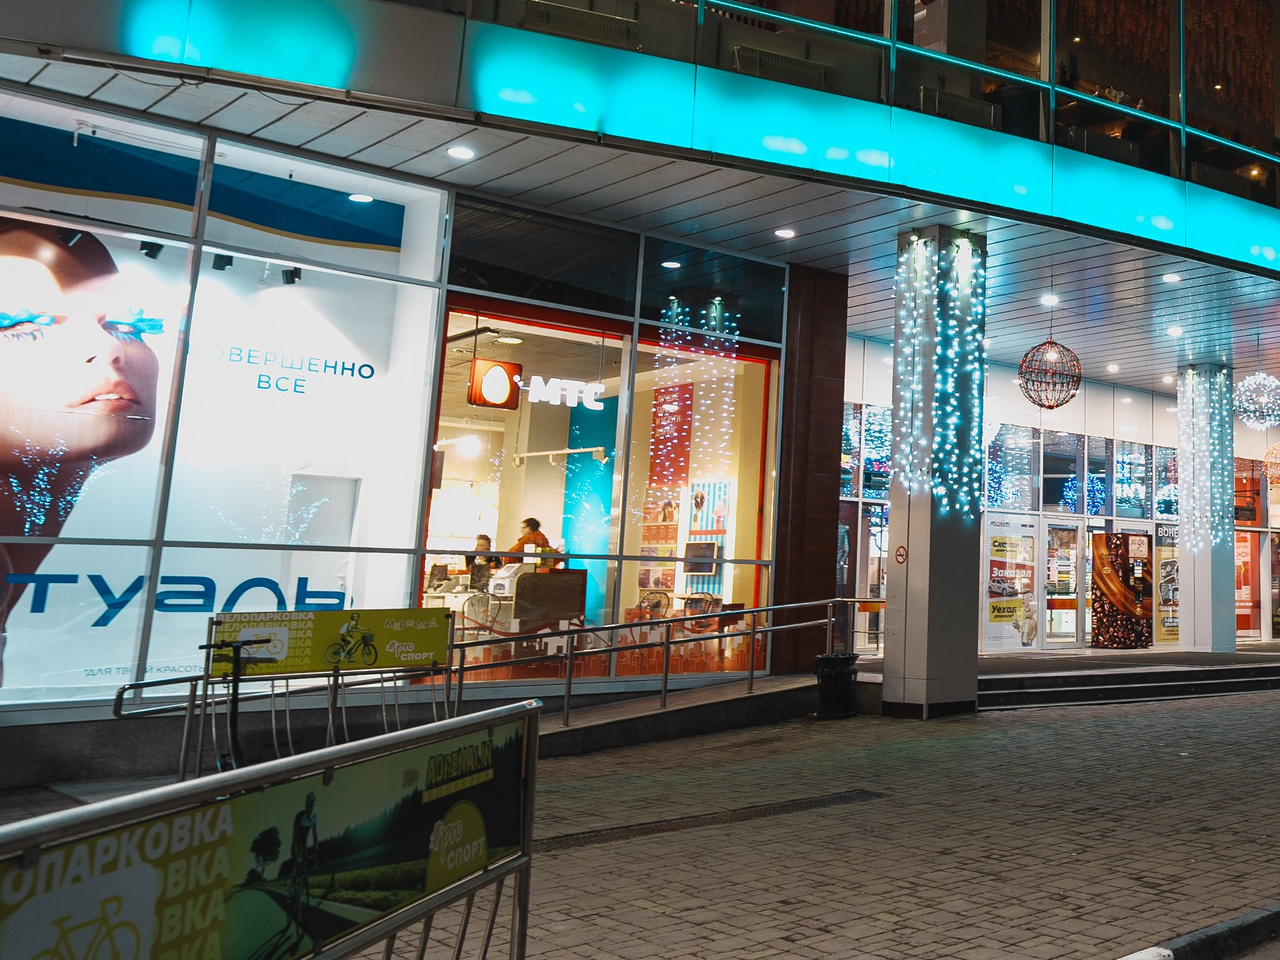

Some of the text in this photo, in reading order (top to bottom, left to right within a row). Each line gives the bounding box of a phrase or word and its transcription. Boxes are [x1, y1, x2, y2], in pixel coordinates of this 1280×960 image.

[218, 347, 375, 380] ВЕРШЕННО
[257, 373, 306, 394] ВСЁ
[528, 375, 606, 411] МТС
[990, 520, 1011, 528] maxim
[992, 567, 1032, 578] Заказал
[991, 605, 1017, 614] Уехал
[217, 612, 315, 622] ВЕЛОПАРКОВКА
[400, 652, 435, 661] СПОРТ
[116, 665, 154, 675] ТВЙ
[425, 738, 494, 787] ADRENALIN
[446, 837, 486, 870] СПОРТ
